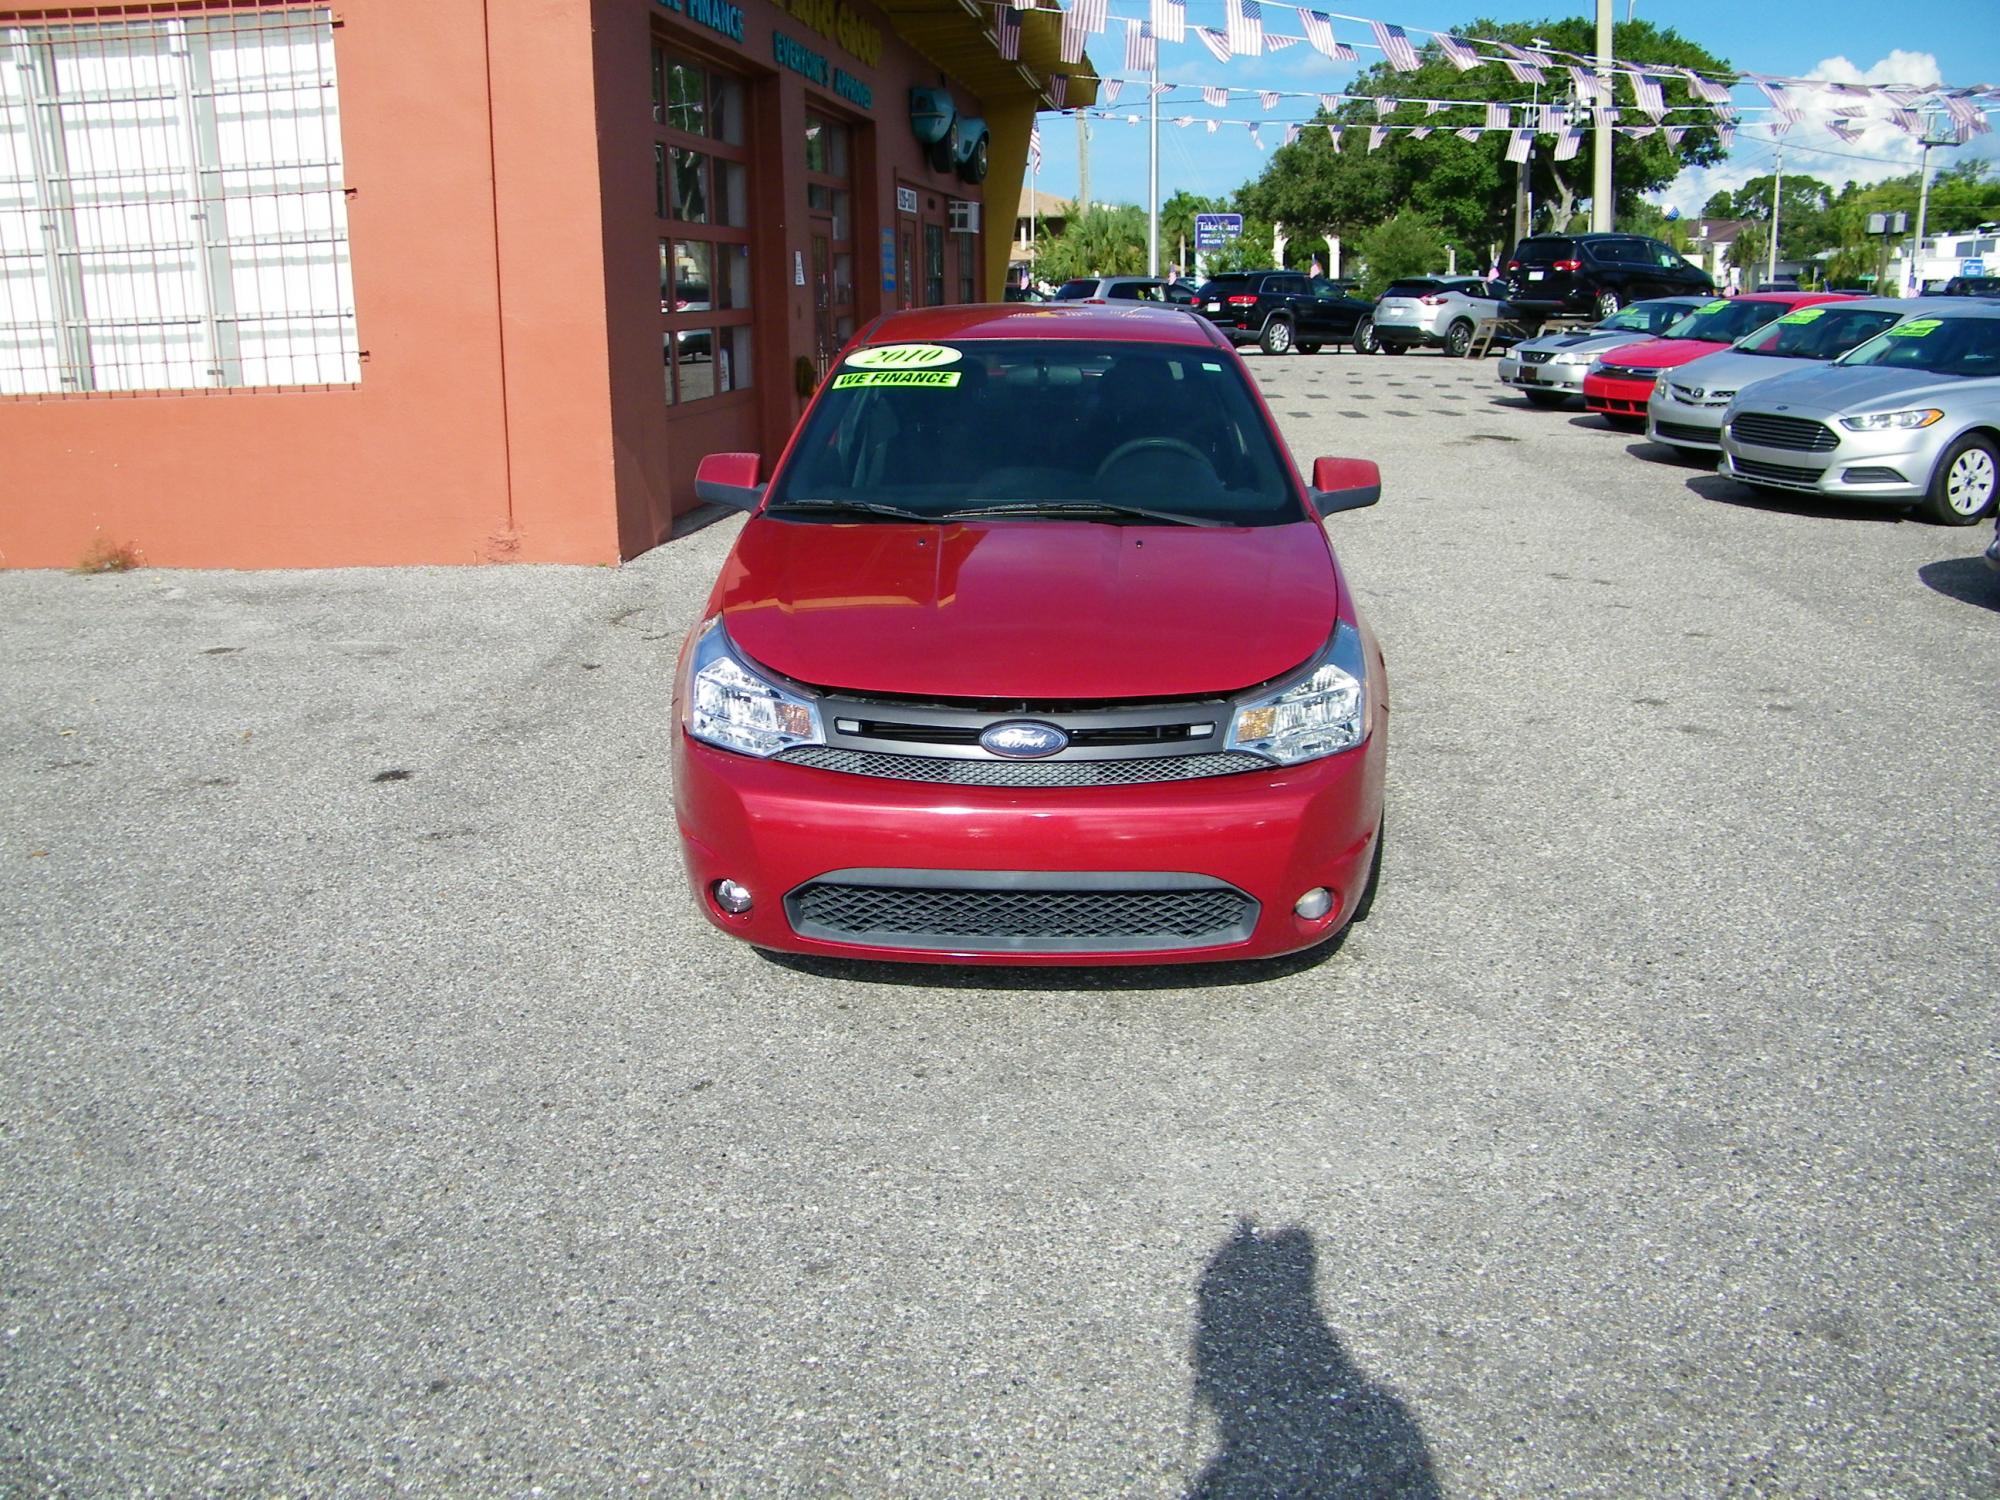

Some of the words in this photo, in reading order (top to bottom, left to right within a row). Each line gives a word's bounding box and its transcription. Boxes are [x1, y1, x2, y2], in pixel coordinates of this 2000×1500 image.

[1199, 222, 1218, 231] Take
[863, 349, 943, 364] 2010
[839, 373, 870, 386] WE
[870, 372, 953, 385] FINANCE
[990, 728, 1047, 748] Ford
